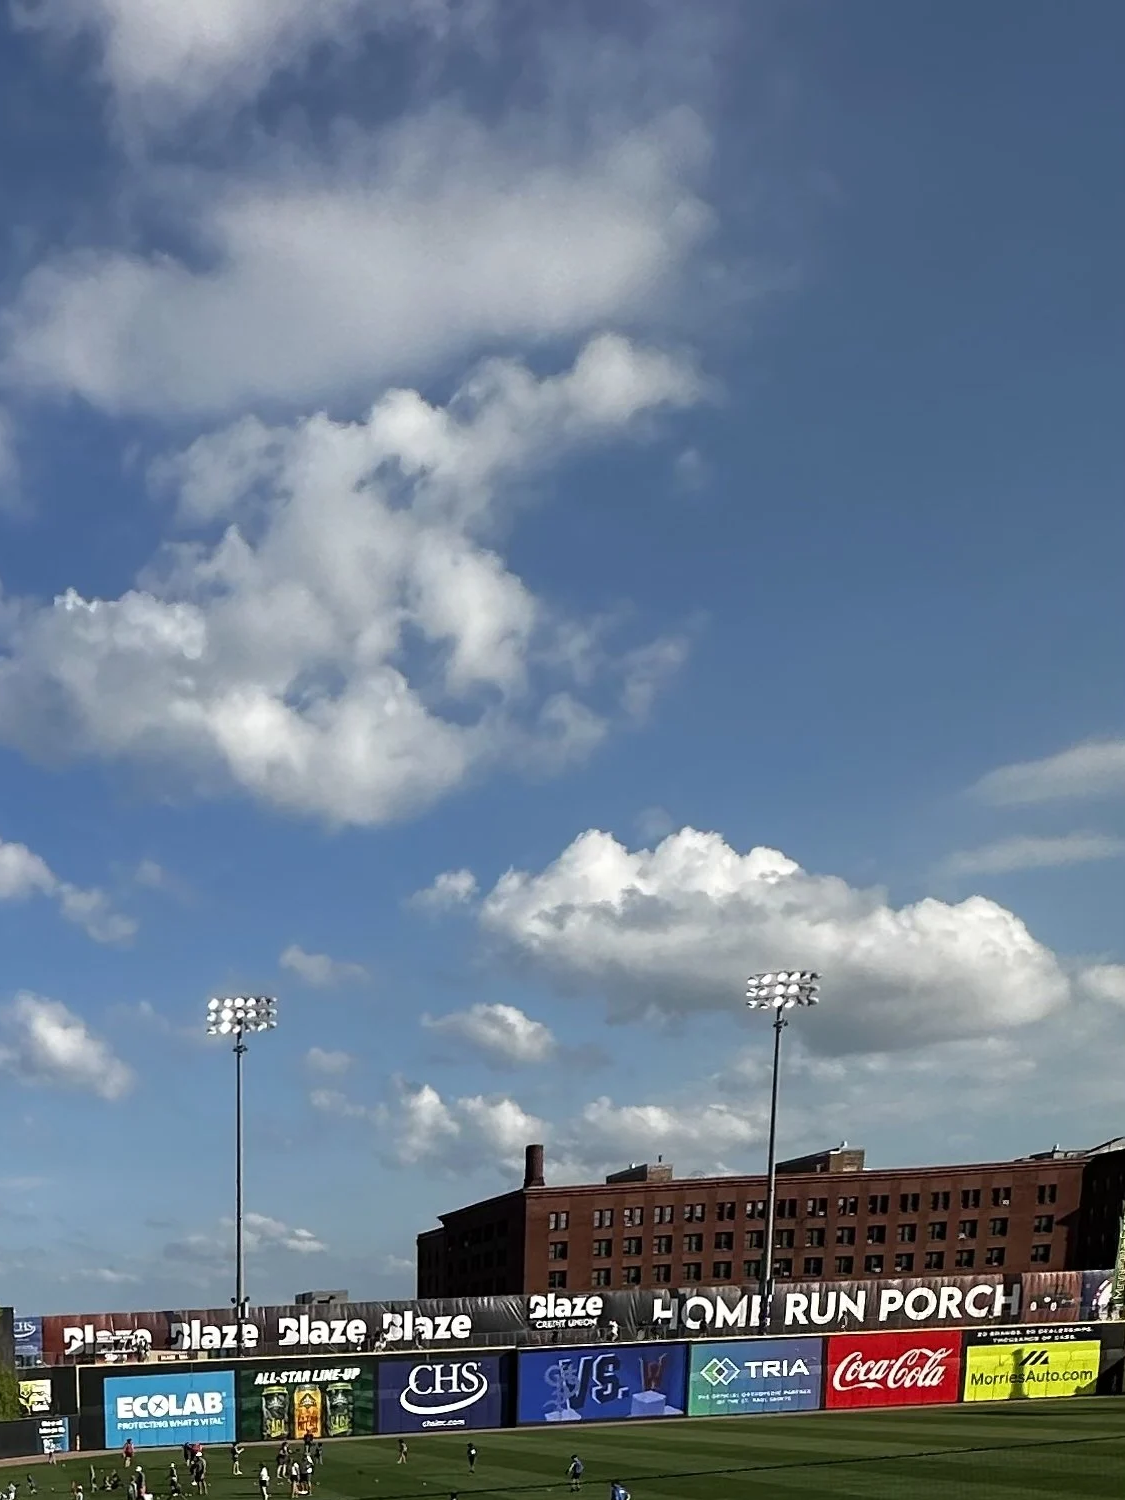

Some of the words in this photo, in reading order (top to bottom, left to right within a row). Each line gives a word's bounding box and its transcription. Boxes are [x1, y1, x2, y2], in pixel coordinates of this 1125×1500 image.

[530, 1293, 604, 1319] Blaze
[784, 1290, 866, 1326] RUN
[878, 1284, 1021, 1322] PORCH
[170, 1319, 259, 1350] Blaze
[278, 1314, 367, 1345] Blaze
[382, 1310, 472, 1341] Blaze
[254, 1370, 311, 1385] ALL-STAR
[311, 1367, 361, 1382] LINE-UP
[408, 1362, 479, 1395] CHS
[744, 1359, 810, 1379] TRIA
[832, 1347, 954, 1391] Coca-Cola
[970, 1369, 1093, 1386] MorriesAuto.com
[116, 1392, 224, 1419] ECOLAB
